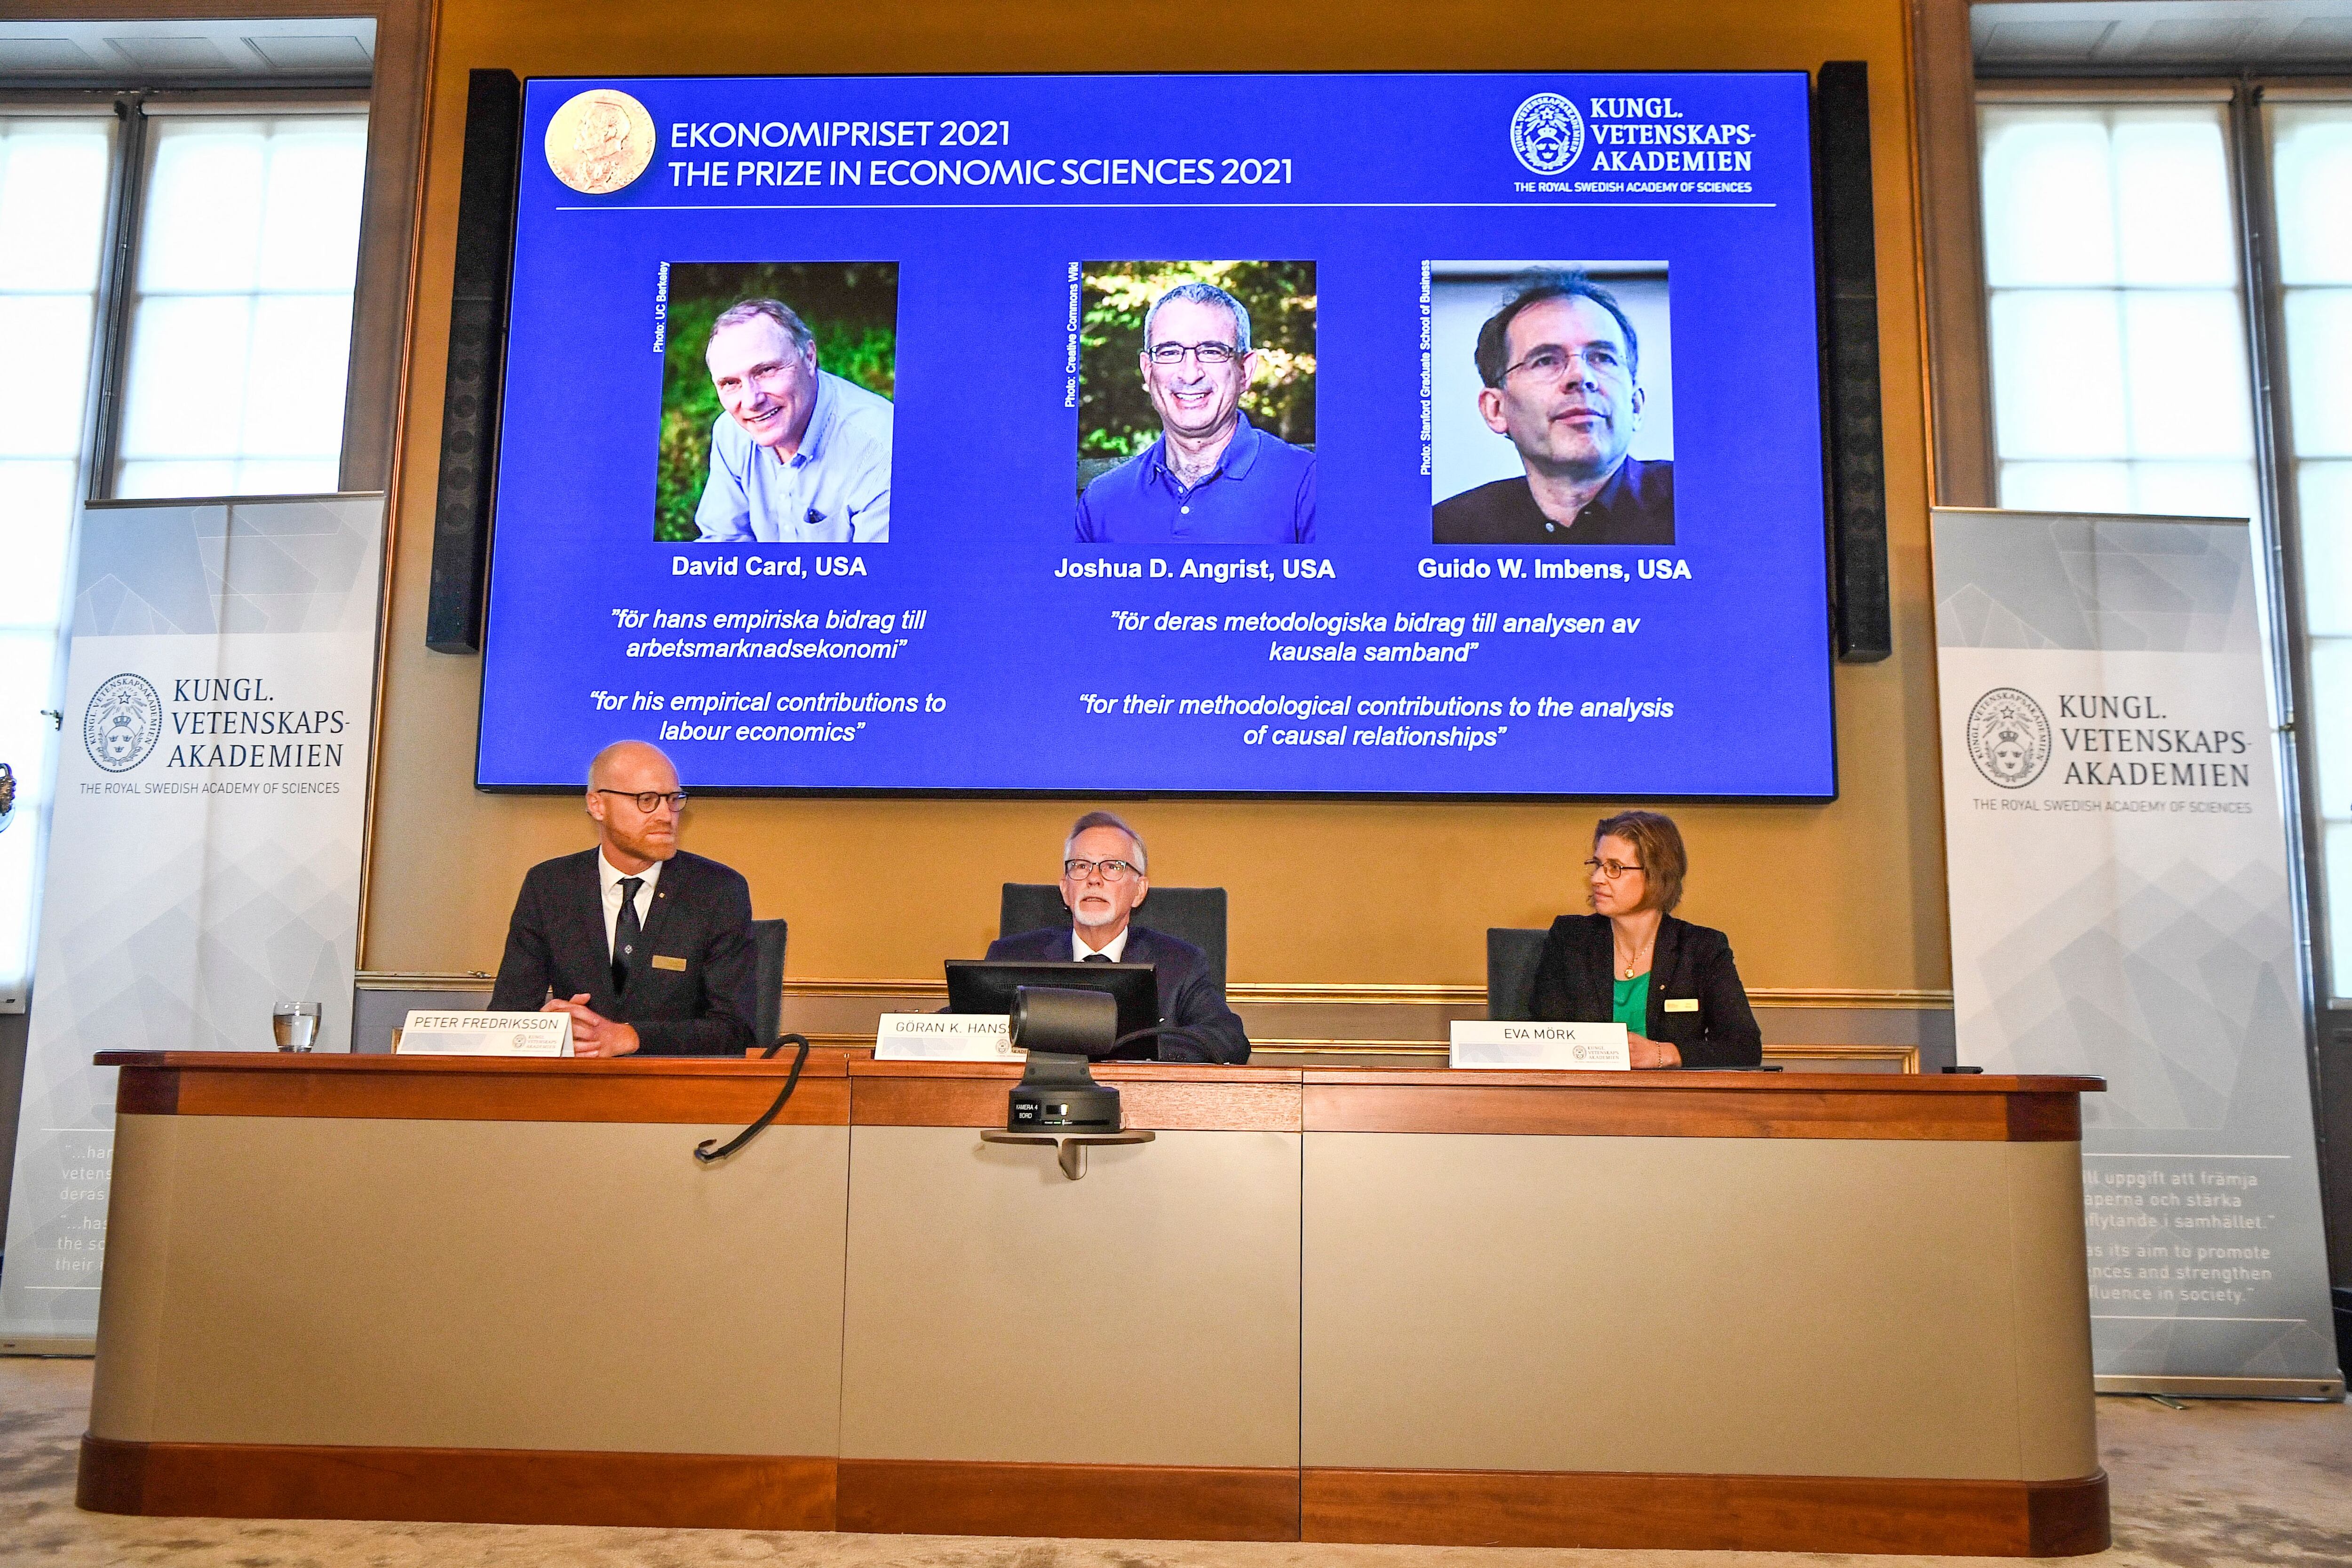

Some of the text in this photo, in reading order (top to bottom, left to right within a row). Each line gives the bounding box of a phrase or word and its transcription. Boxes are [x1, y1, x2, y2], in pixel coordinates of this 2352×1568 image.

[1591, 98, 1683, 118] KUNGL.
[672, 121, 1008, 147] EKONOMIPRISET 2021
[1590, 125, 1755, 144] VETENSKAPS-
[668, 159, 1291, 186] THE PRIZE IN ECONOMIC SCIENCES 2021
[1591, 151, 1751, 171] AKADEMIEN
[1514, 183, 1752, 192] THE ROYAL SWEDISH ACADEMY OF SCIENCES
[653, 262, 669, 352] Photo: UC Berkeley
[1065, 262, 1078, 407] Photo: Creative Commons Wiki
[1420, 260, 1430, 475] Photo: Stanford Graduate School of Business
[673, 557, 867, 579] David Card, USA
[1055, 558, 1335, 582] Joshua D. Angrist, USA
[1418, 558, 1692, 582] Guido W. Imbens, USA
[653, 609, 707, 628] hans
[714, 610, 818, 633] empiriska
[826, 610, 895, 633] bidrag
[902, 610, 927, 629] till
[1154, 612, 1217, 630] deras
[1224, 612, 1387, 636] metodologiska
[1394, 613, 1465, 637] bidrag
[1472, 613, 1497, 632] till
[1503, 613, 1605, 637] analysen
[1612, 618, 1640, 633] av
[1269, 641, 1356, 661] kausala
[173, 678, 273, 701] KUNGL.
[88, 678, 157, 745] KUNGL. VETENSKAPSAKADEMIEN
[632, 691, 664, 710] his
[671, 692, 771, 715] empirical
[777, 692, 918, 712] contributions
[925, 693, 946, 712] to
[1123, 694, 1175, 714] their
[1179, 695, 1351, 719] methodological
[1358, 696, 1502, 716] contributions
[1510, 697, 1530, 716] to
[1538, 697, 1573, 716] the
[1581, 697, 1674, 722] analysis
[2058, 695, 2166, 719] KUNGL.
[171, 711, 350, 734] VETENSKAPS-
[660, 721, 731, 740] labour
[1244, 725, 1268, 744] of
[1272, 726, 1347, 745] causal
[2062, 729, 2251, 754] VETENSKAPS-
[166, 744, 344, 767] AKADEMIEN
[2063, 762, 2249, 787] AKADEMIEN
[80, 783, 339, 794] THE ROYAL SWEDISH ACADEMY OF SCIENCES
[1973, 798, 2252, 813] THE ROYAL SWEDISH ACADEMY OF SCIENCES
[414, 1017, 558, 1029] PETER FREDRIKSSON
[897, 1020, 1010, 1034] GÖRAN K. HANS
[1505, 1027, 1575, 1040] EVA MÖRK
[60, 1187, 104, 1200] deras
[2150, 1193, 2180, 1206] och
[57, 1236, 82, 1250] the
[2137, 1246, 2168, 1257] aim
[2174, 1245, 2191, 1258] to
[2198, 1246, 2271, 1261] promote
